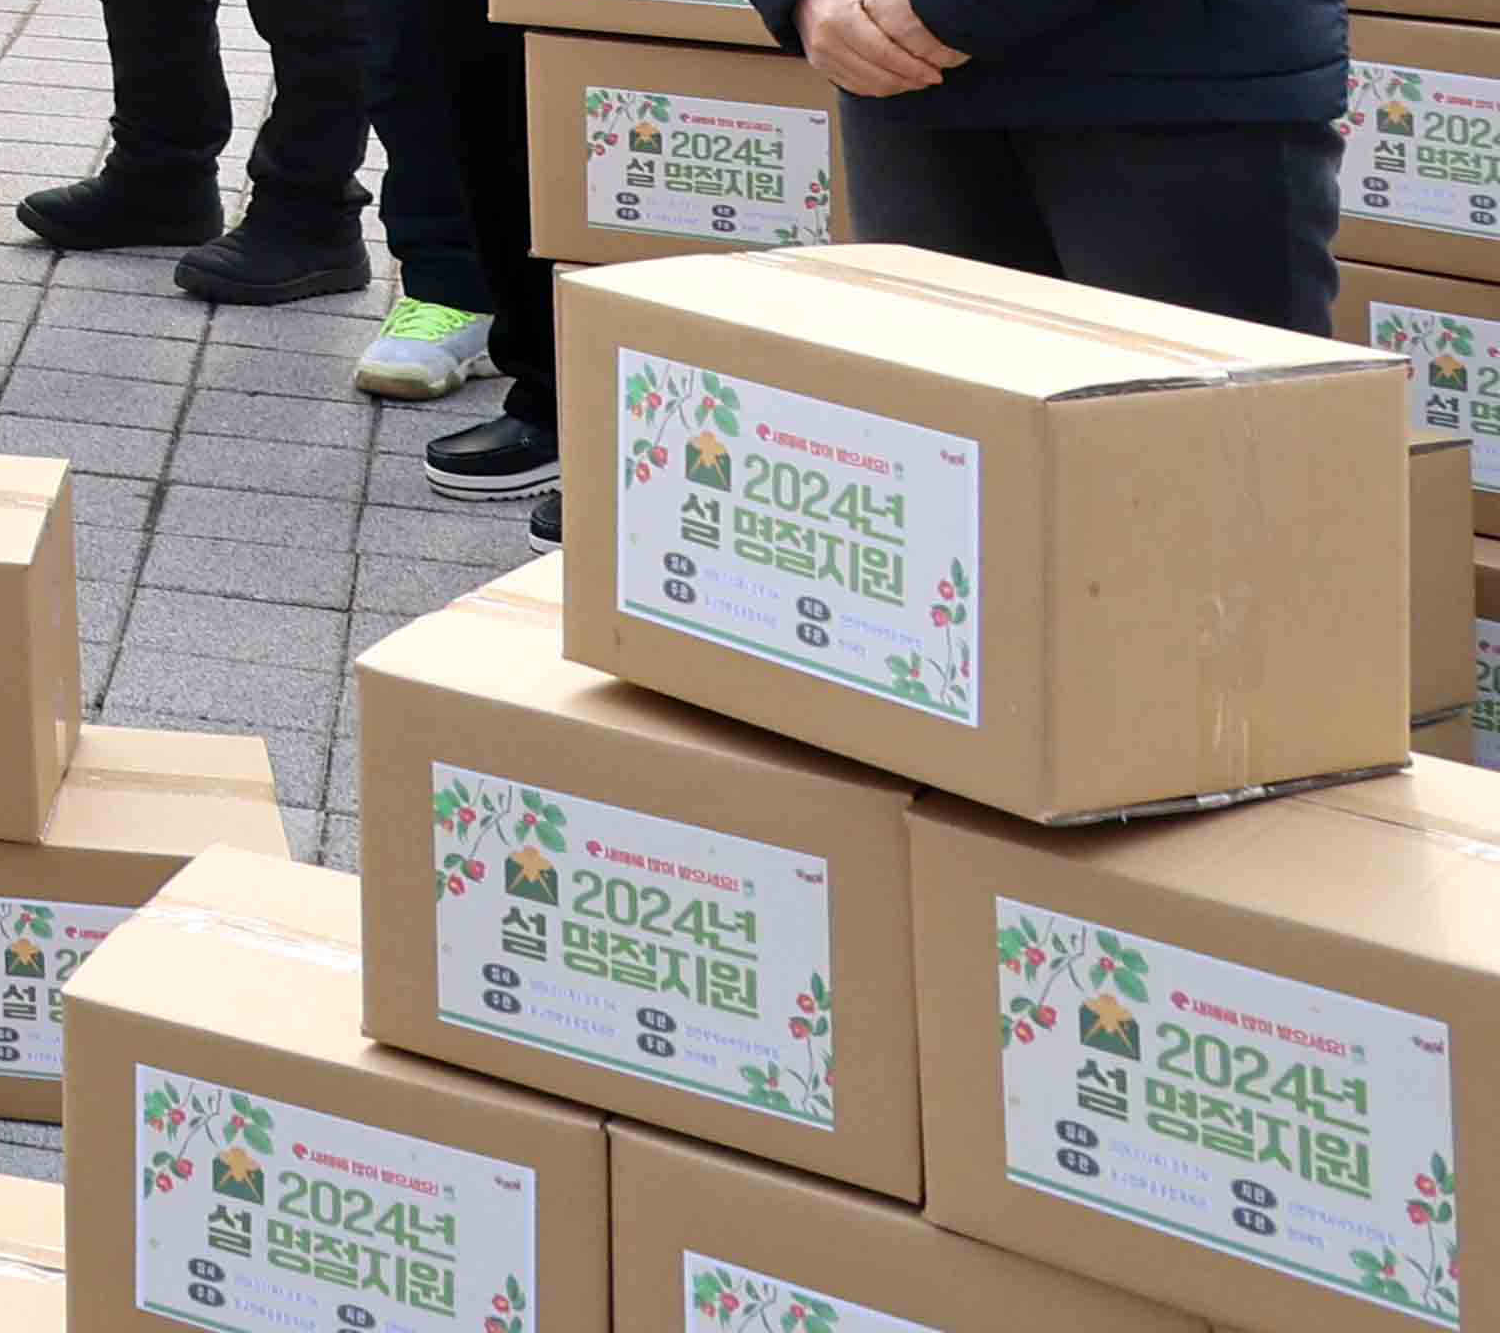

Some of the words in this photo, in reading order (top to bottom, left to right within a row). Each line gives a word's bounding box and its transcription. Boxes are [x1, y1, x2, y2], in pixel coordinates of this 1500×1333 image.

[627, 157, 655, 187] 설
[664, 161, 784, 202] 명절지원
[671, 130, 784, 169] 2024년
[1374, 139, 1406, 174] 설
[743, 453, 904, 546] 2024년
[680, 492, 719, 550] 설
[733, 507, 903, 607] 명절지원
[572, 869, 757, 960] 2024년
[3, 984, 37, 1021] 설
[500, 906, 546, 962] 설
[561, 920, 758, 1019] 명절지원
[1156, 1022, 1368, 1134] 2024년
[1075, 1058, 1127, 1122] 설
[1144, 1077, 1370, 1199] 명절지원
[207, 1204, 251, 1258] 설
[266, 1219, 454, 1317] 명절지원
[277, 1171, 455, 1262] 2024년
